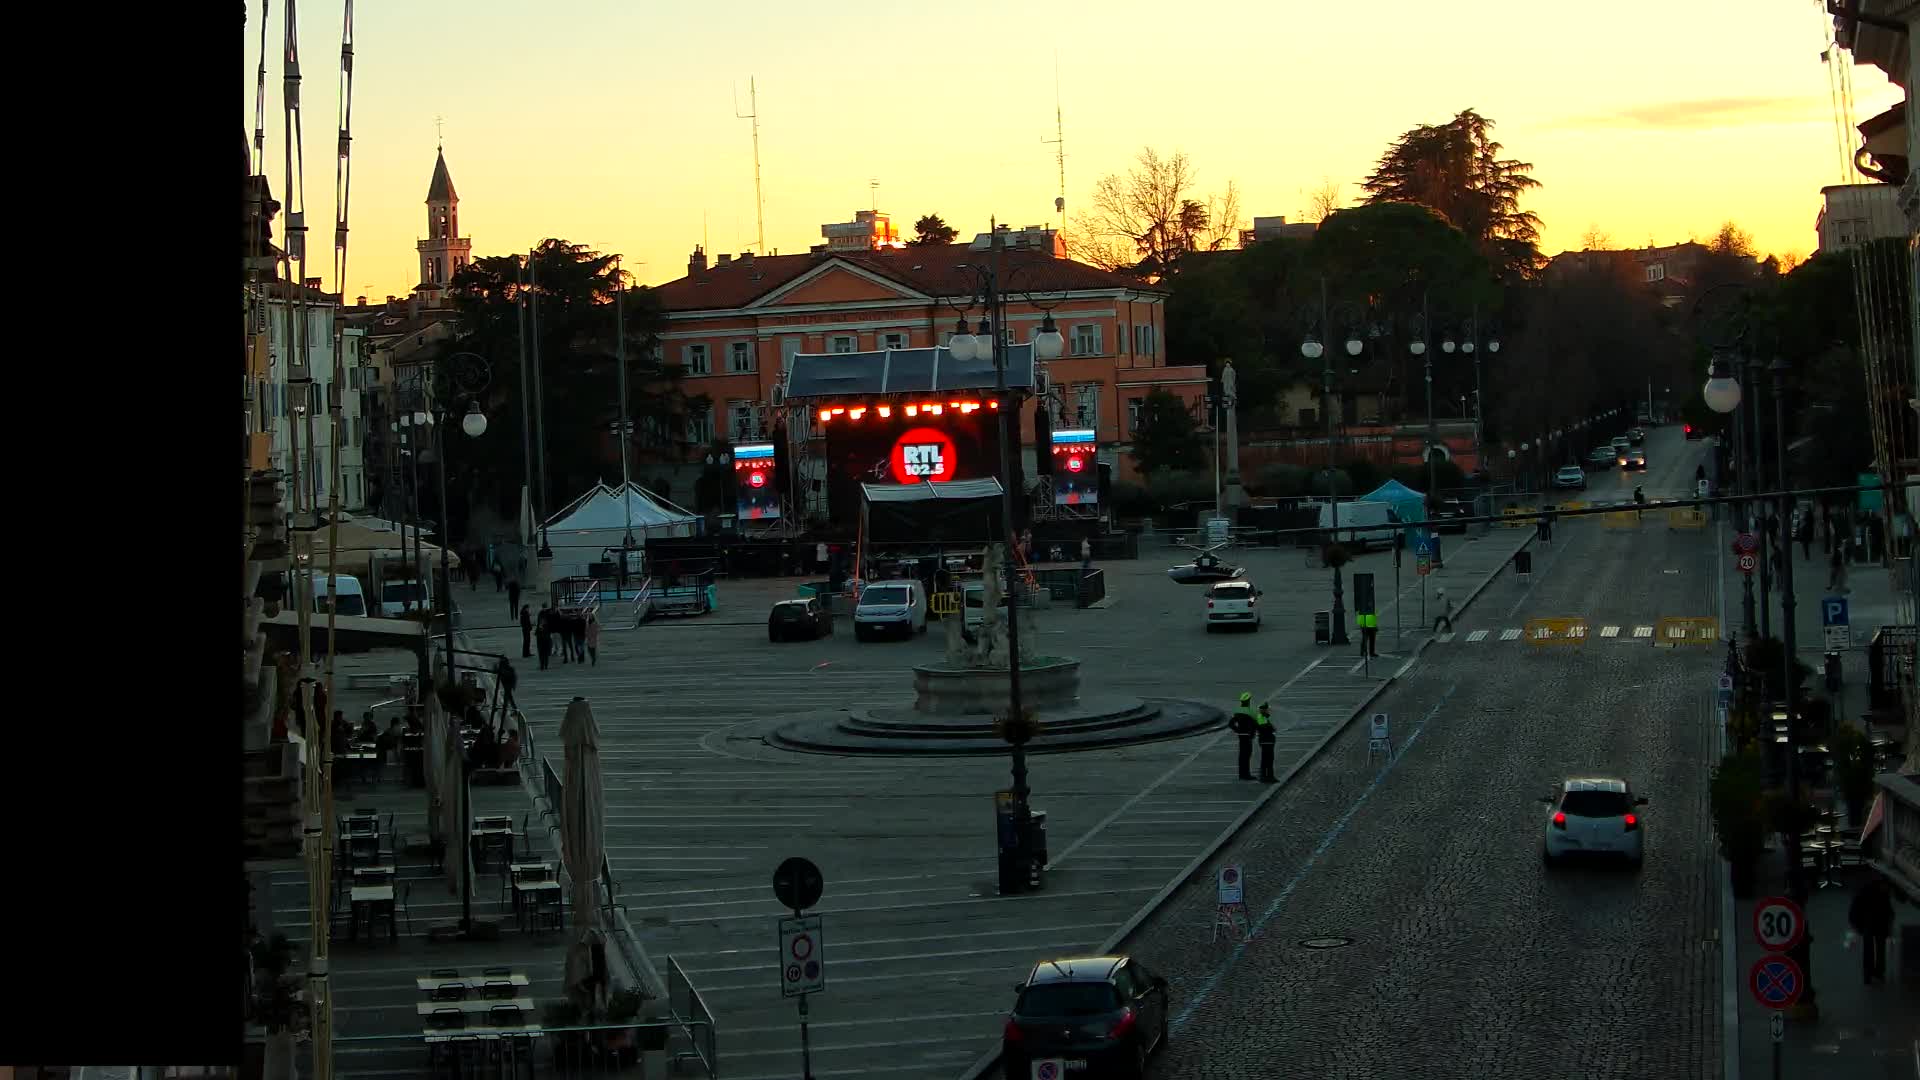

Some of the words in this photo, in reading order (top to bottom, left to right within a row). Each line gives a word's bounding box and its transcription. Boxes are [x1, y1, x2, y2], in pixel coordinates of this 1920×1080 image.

[904, 445, 943, 464] RTL
[904, 463, 945, 476] 102.5
[1742, 557, 1753, 567] 20
[1827, 602, 1842, 623] P
[1762, 911, 1791, 938] 30
